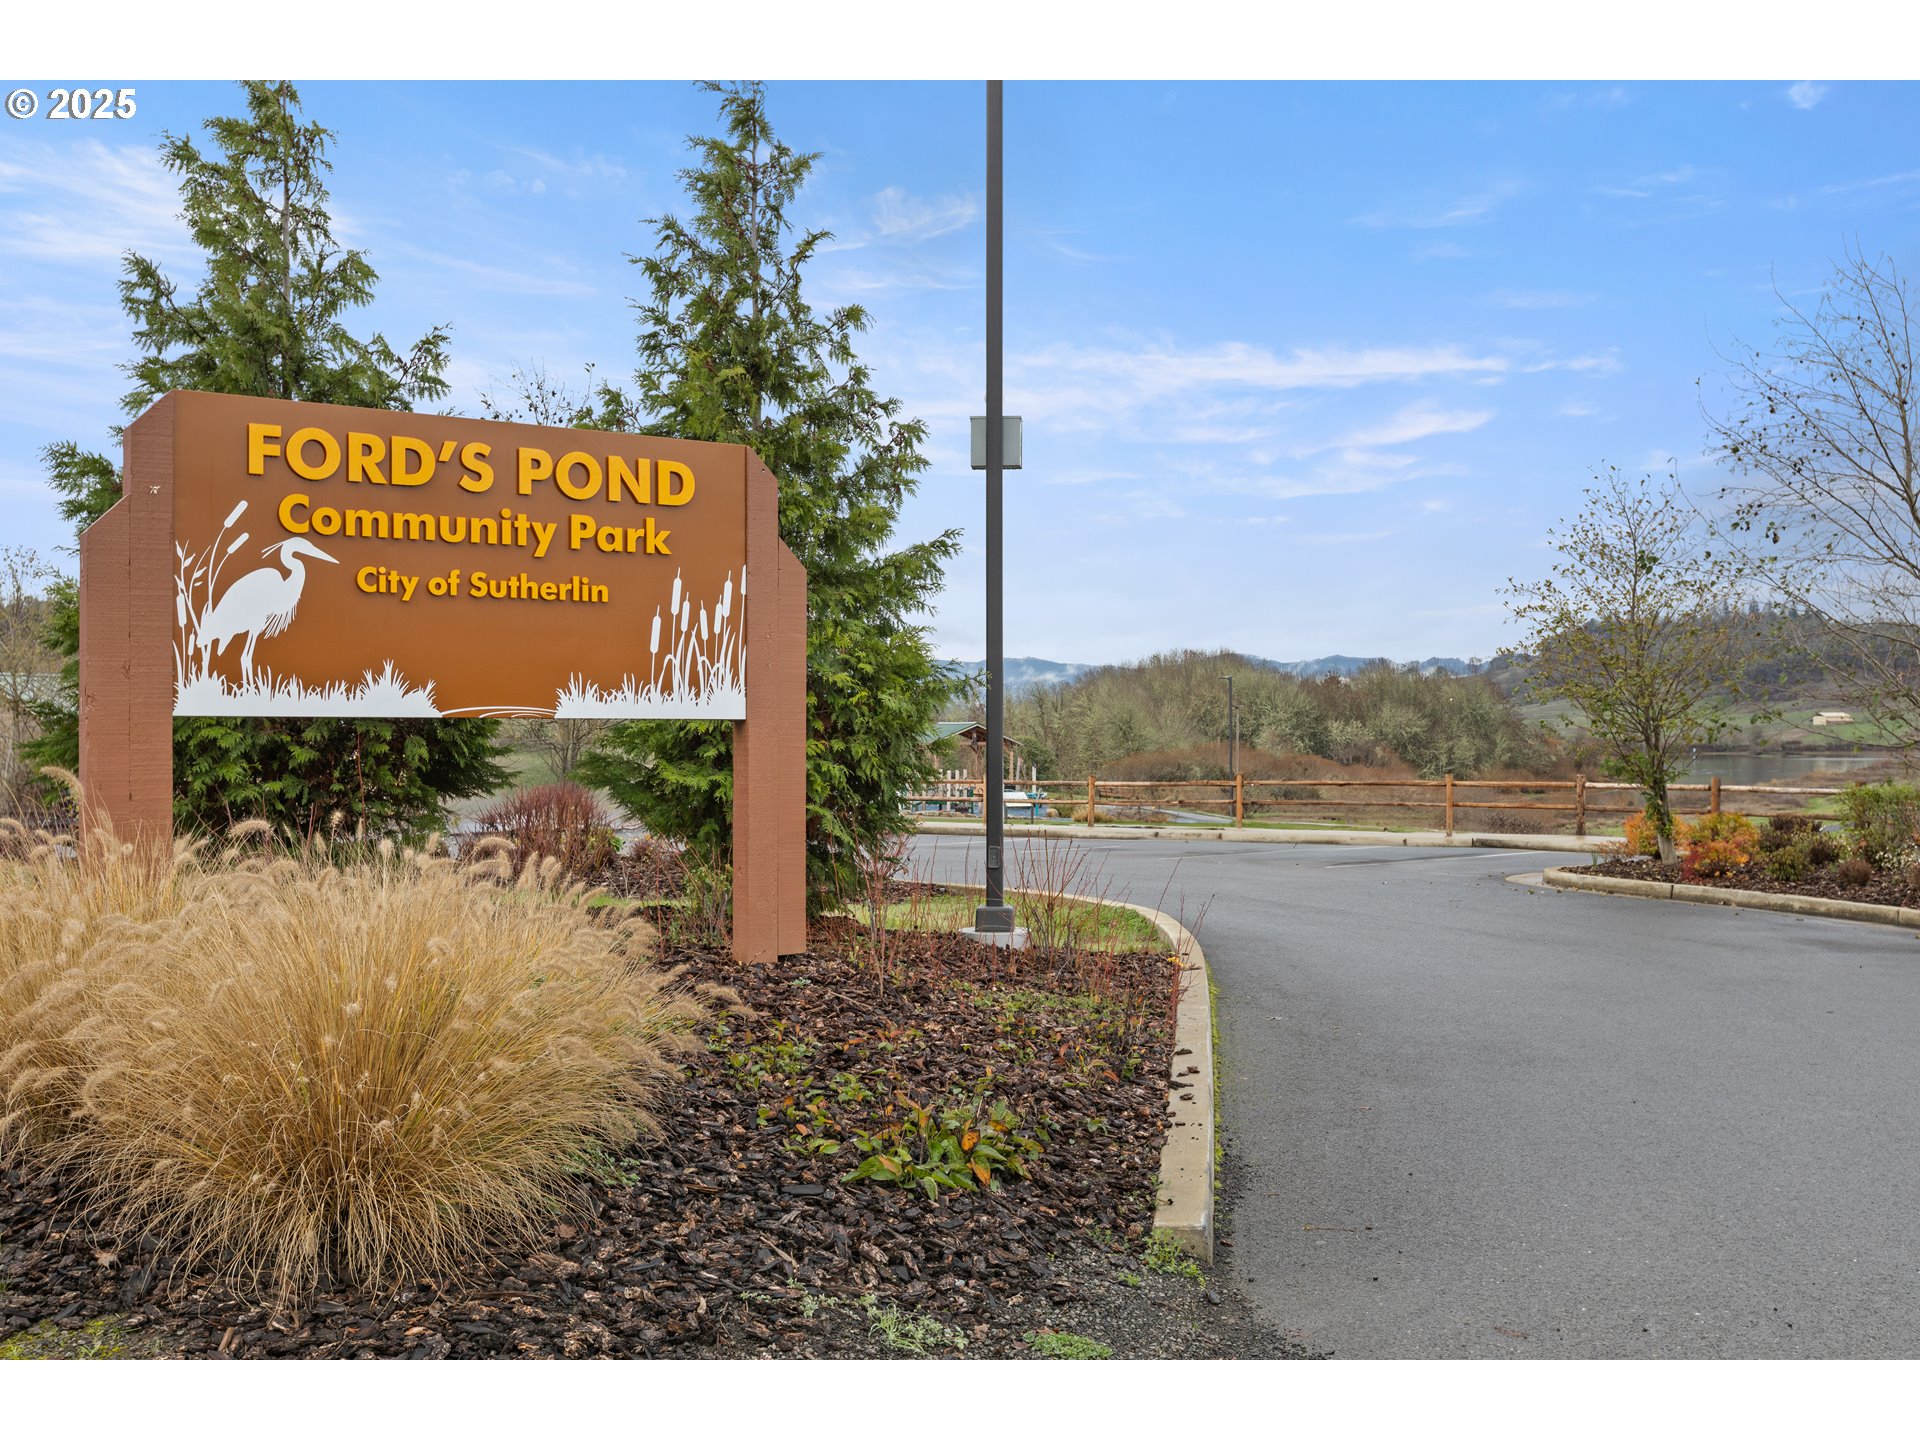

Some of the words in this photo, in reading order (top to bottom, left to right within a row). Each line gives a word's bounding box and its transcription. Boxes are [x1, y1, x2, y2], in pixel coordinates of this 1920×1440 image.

[247, 422, 495, 493] FORD'S
[518, 446, 696, 507] POND
[278, 493, 558, 558] Community
[570, 513, 673, 555] Park
[356, 565, 420, 602] City
[428, 568, 461, 597] of
[469, 570, 610, 603] Sutherlin
